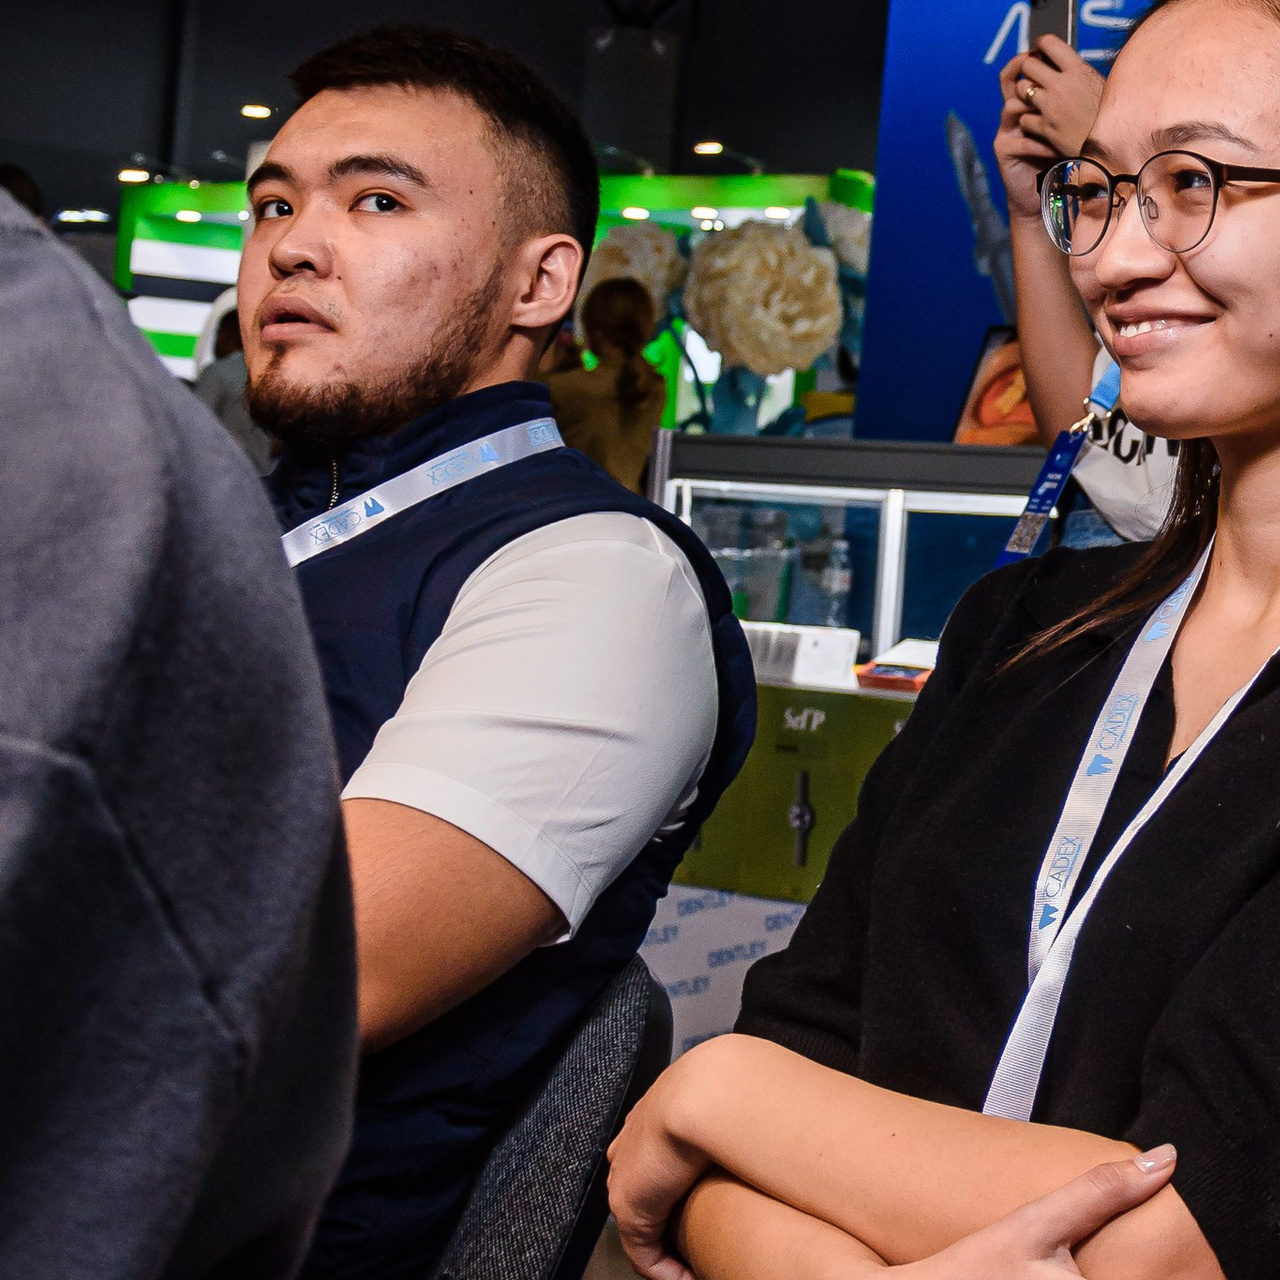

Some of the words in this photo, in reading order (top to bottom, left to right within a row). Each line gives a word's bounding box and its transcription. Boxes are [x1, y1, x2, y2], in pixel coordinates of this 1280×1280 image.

[308, 511, 362, 546] CADEX
[1100, 691, 1139, 751] CADEX
[1044, 835, 1081, 899] CADEX
